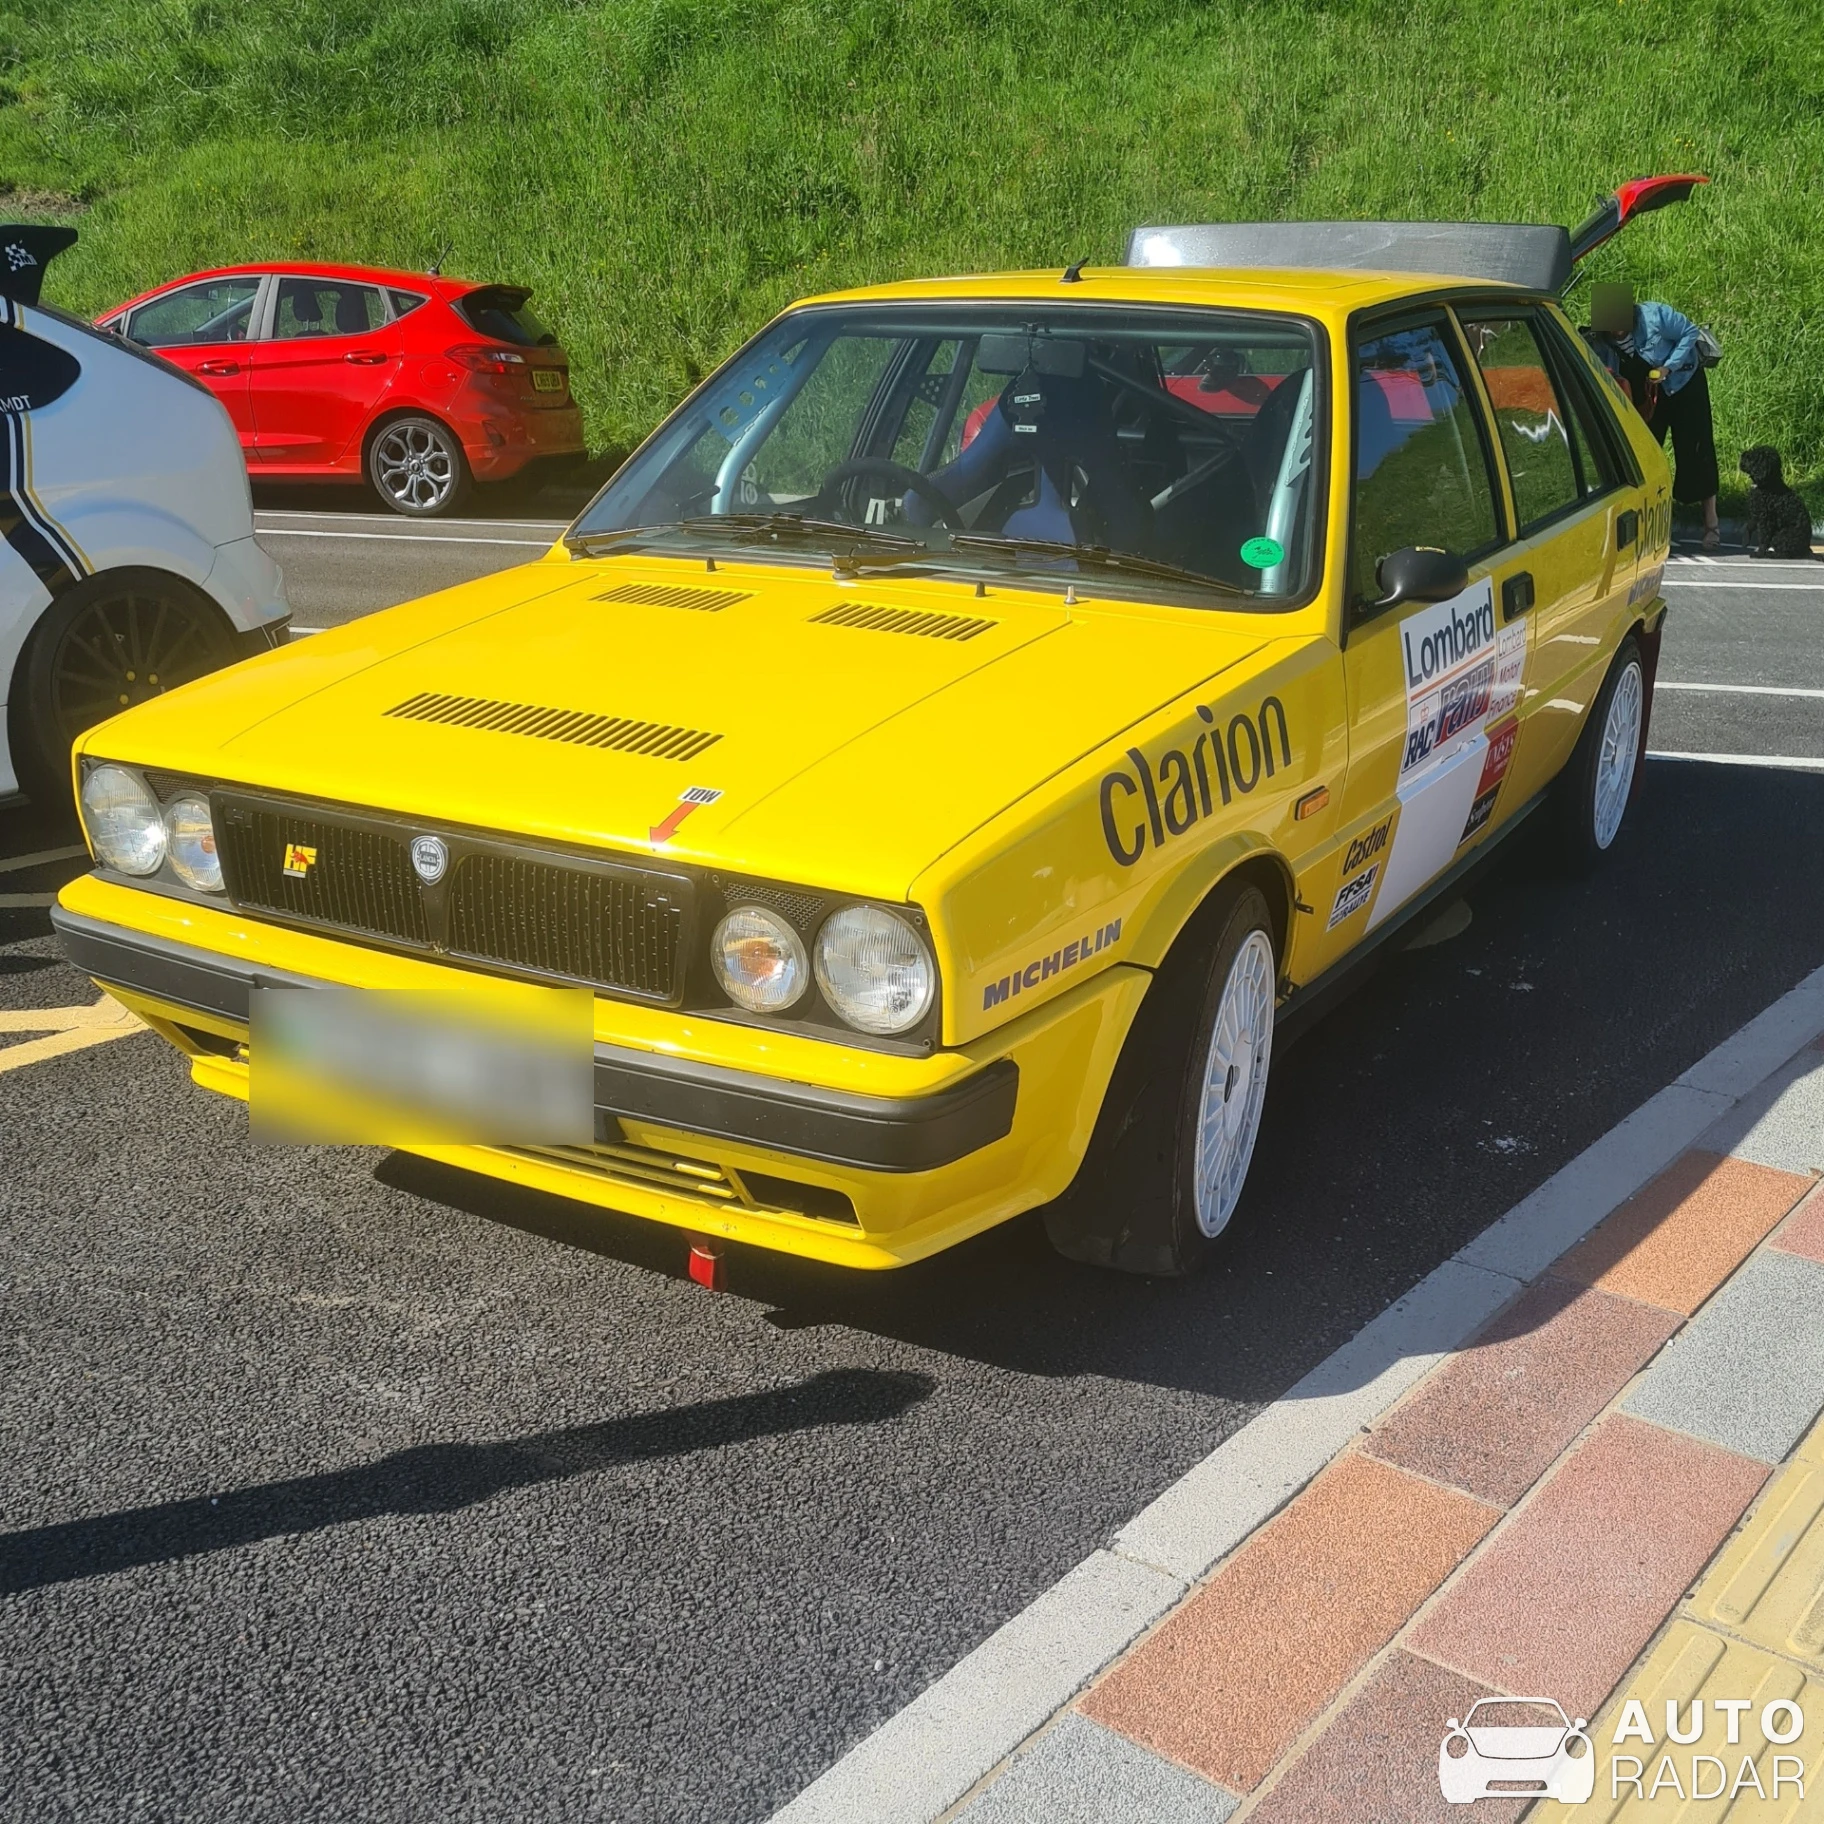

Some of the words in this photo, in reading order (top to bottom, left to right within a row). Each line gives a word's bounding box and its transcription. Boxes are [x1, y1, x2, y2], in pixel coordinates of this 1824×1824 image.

[0, 395, 31, 412] MDT
[1405, 587, 1494, 688] Lombard
[1403, 718, 1436, 769] RAC
[682, 787, 722, 803] TOW
[1342, 814, 1394, 876] Castrol
[1335, 866, 1375, 909] FFSA
[982, 917, 1122, 1011] MICHELIN
